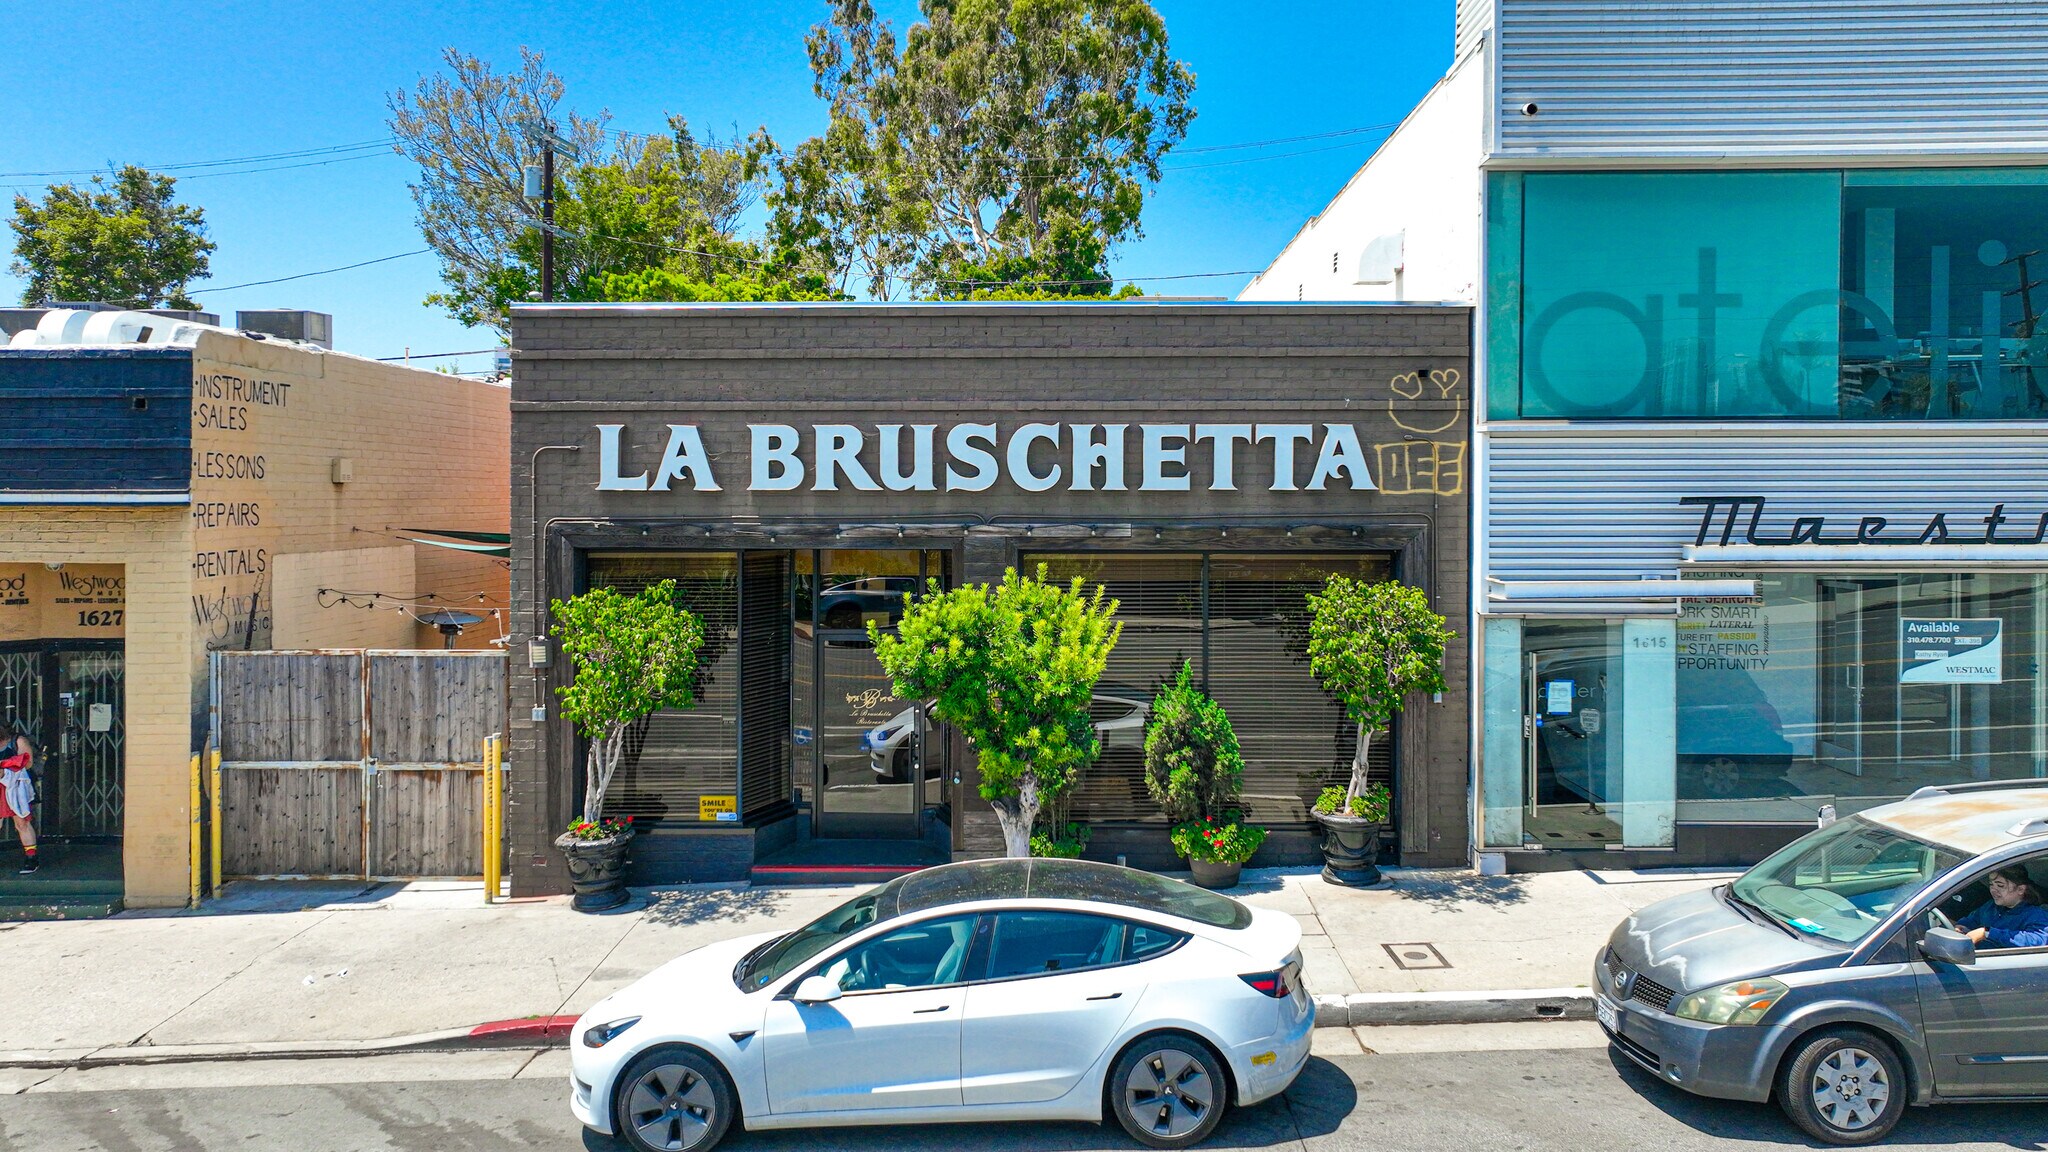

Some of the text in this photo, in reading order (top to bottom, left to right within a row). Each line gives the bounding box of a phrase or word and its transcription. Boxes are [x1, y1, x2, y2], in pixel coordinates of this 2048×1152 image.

[1526, 240, 2048, 418] ateli
[199, 375, 291, 408] INSTRUMENT
[199, 403, 248, 431] SALES
[197, 452, 266, 479] LESSONS
[595, 422, 1379, 492] LA BRUSCHETTA
[197, 503, 260, 529] REPAIRS
[196, 548, 266, 578] RENTALS
[78, 610, 124, 626] 1627
[1711, 606, 1760, 619] SMART
[234, 616, 270, 634] MUSIC
[1709, 620, 1755, 629] LATERAL
[1908, 622, 1960, 632] Available
[1633, 637, 1667, 648] 1615
[1700, 634, 1713, 642] FIT
[1717, 632, 1757, 640] PASSION
[1689, 643, 1759, 656] STAFFING
[1946, 666, 1996, 674] WESTMAC
